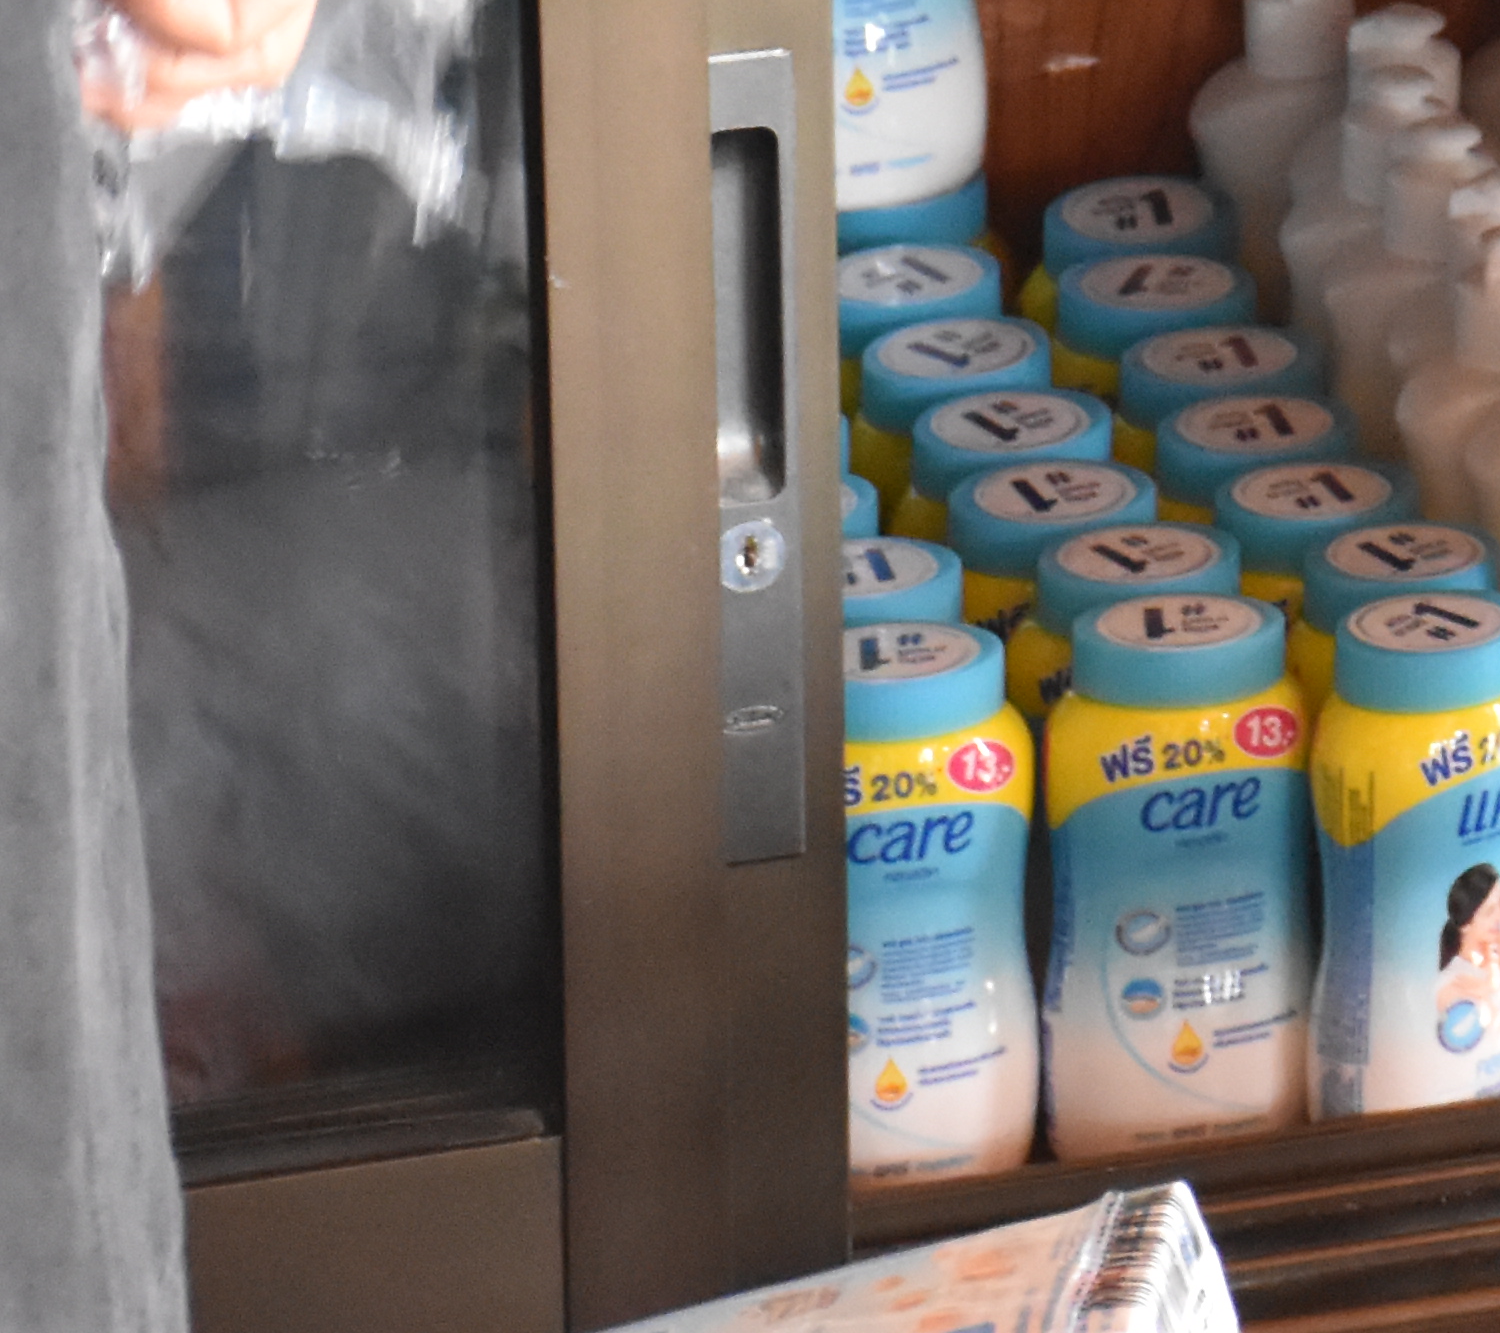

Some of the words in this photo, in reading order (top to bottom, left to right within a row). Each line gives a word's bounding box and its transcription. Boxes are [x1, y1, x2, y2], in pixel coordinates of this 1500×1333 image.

[1100, 735, 1155, 783] ฟรี
[1163, 738, 1226, 770] 20%
[1420, 733, 1474, 786] ฟรี
[870, 771, 938, 803] 20%
[1140, 776, 1262, 833] care
[846, 810, 975, 865] care
